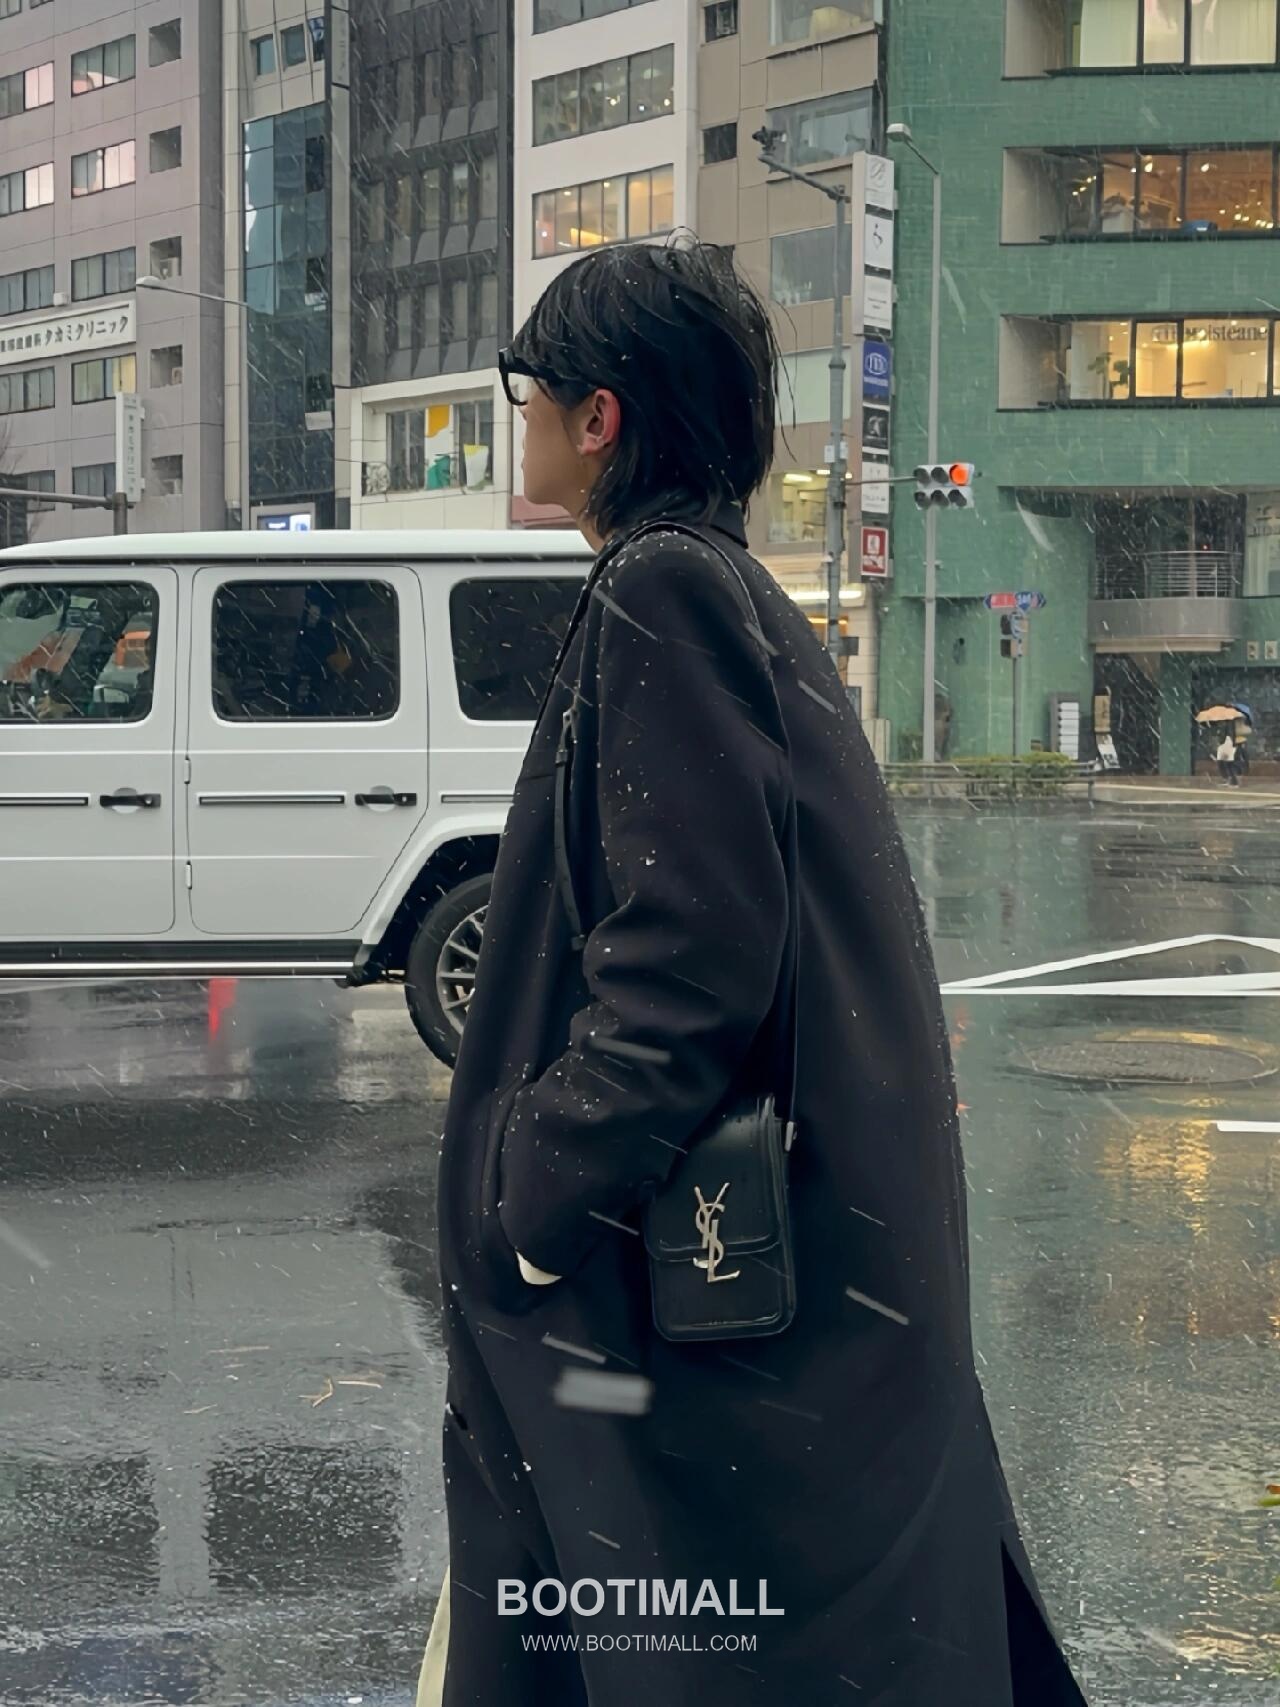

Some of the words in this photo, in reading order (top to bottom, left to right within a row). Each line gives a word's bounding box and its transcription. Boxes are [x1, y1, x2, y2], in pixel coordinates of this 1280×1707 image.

[45, 316, 129, 345] タカミクリニック
[694, 1182, 741, 1283] YSL
